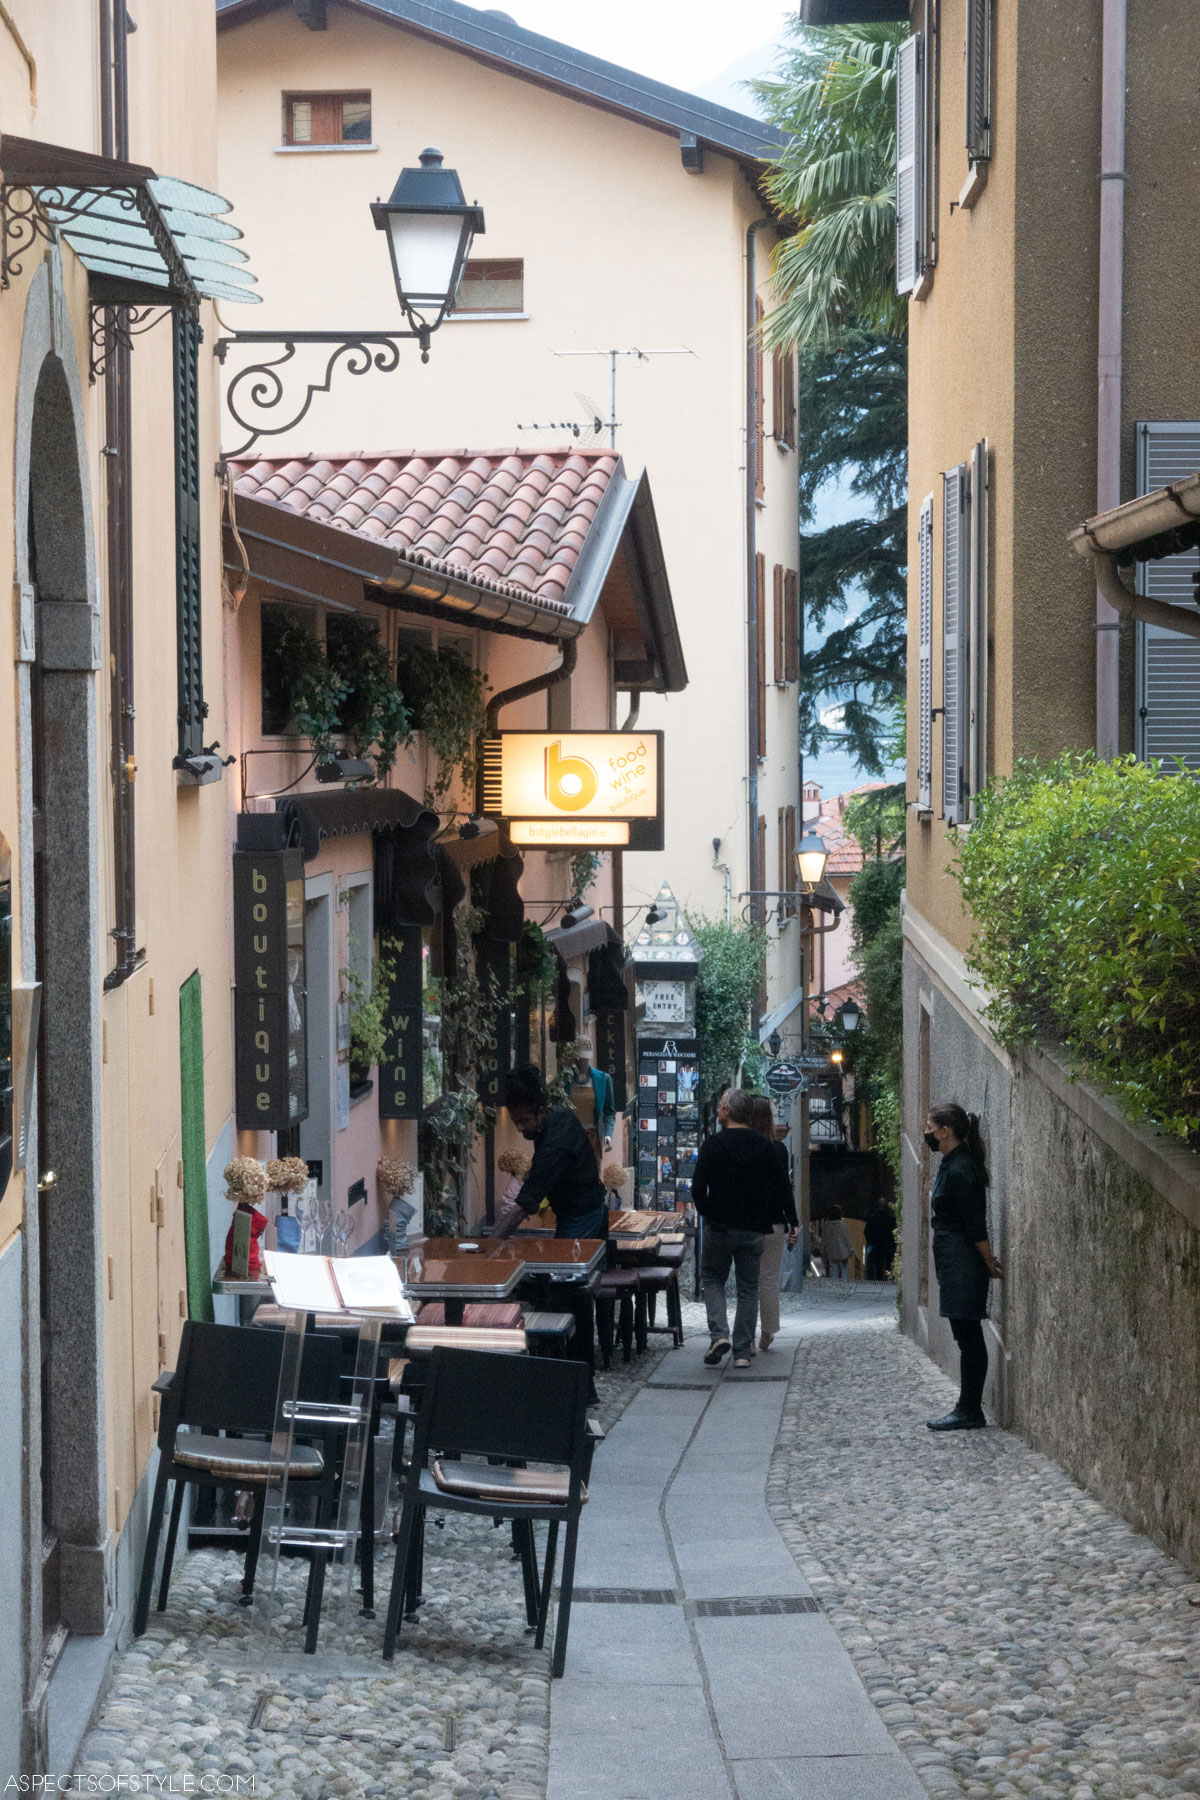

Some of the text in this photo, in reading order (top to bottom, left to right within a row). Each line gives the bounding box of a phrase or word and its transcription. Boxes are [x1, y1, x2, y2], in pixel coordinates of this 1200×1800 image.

[609, 740, 647, 772] food
[609, 764, 646, 790] wine
[609, 788, 646, 812] boutique
[252, 868, 271, 1111] boutique
[391, 1015, 410, 1107] wine
[488, 1037, 499, 1094] ood
